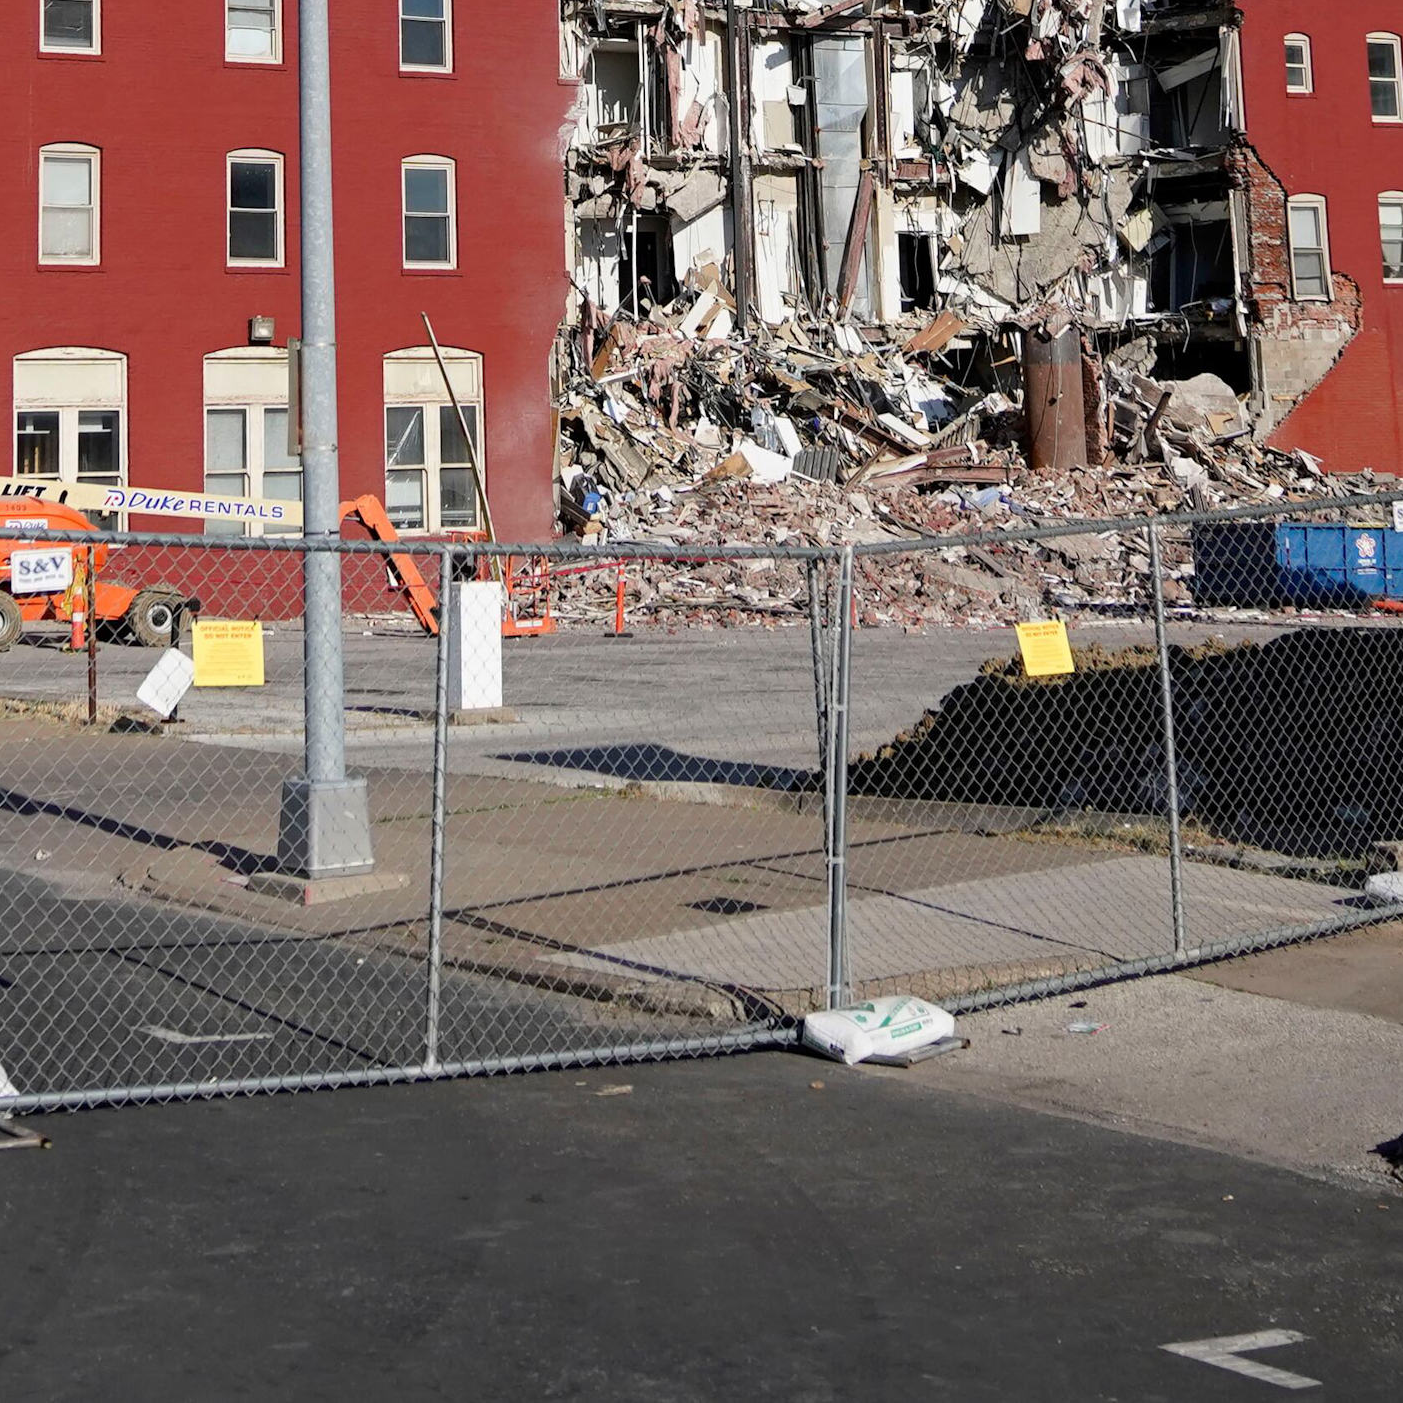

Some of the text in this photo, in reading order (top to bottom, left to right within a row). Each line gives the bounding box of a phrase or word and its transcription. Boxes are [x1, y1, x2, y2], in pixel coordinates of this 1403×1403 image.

[1, 484, 47, 498] LIFT
[189, 500, 284, 519] RENTALS
[18, 556, 66, 576] S&V
